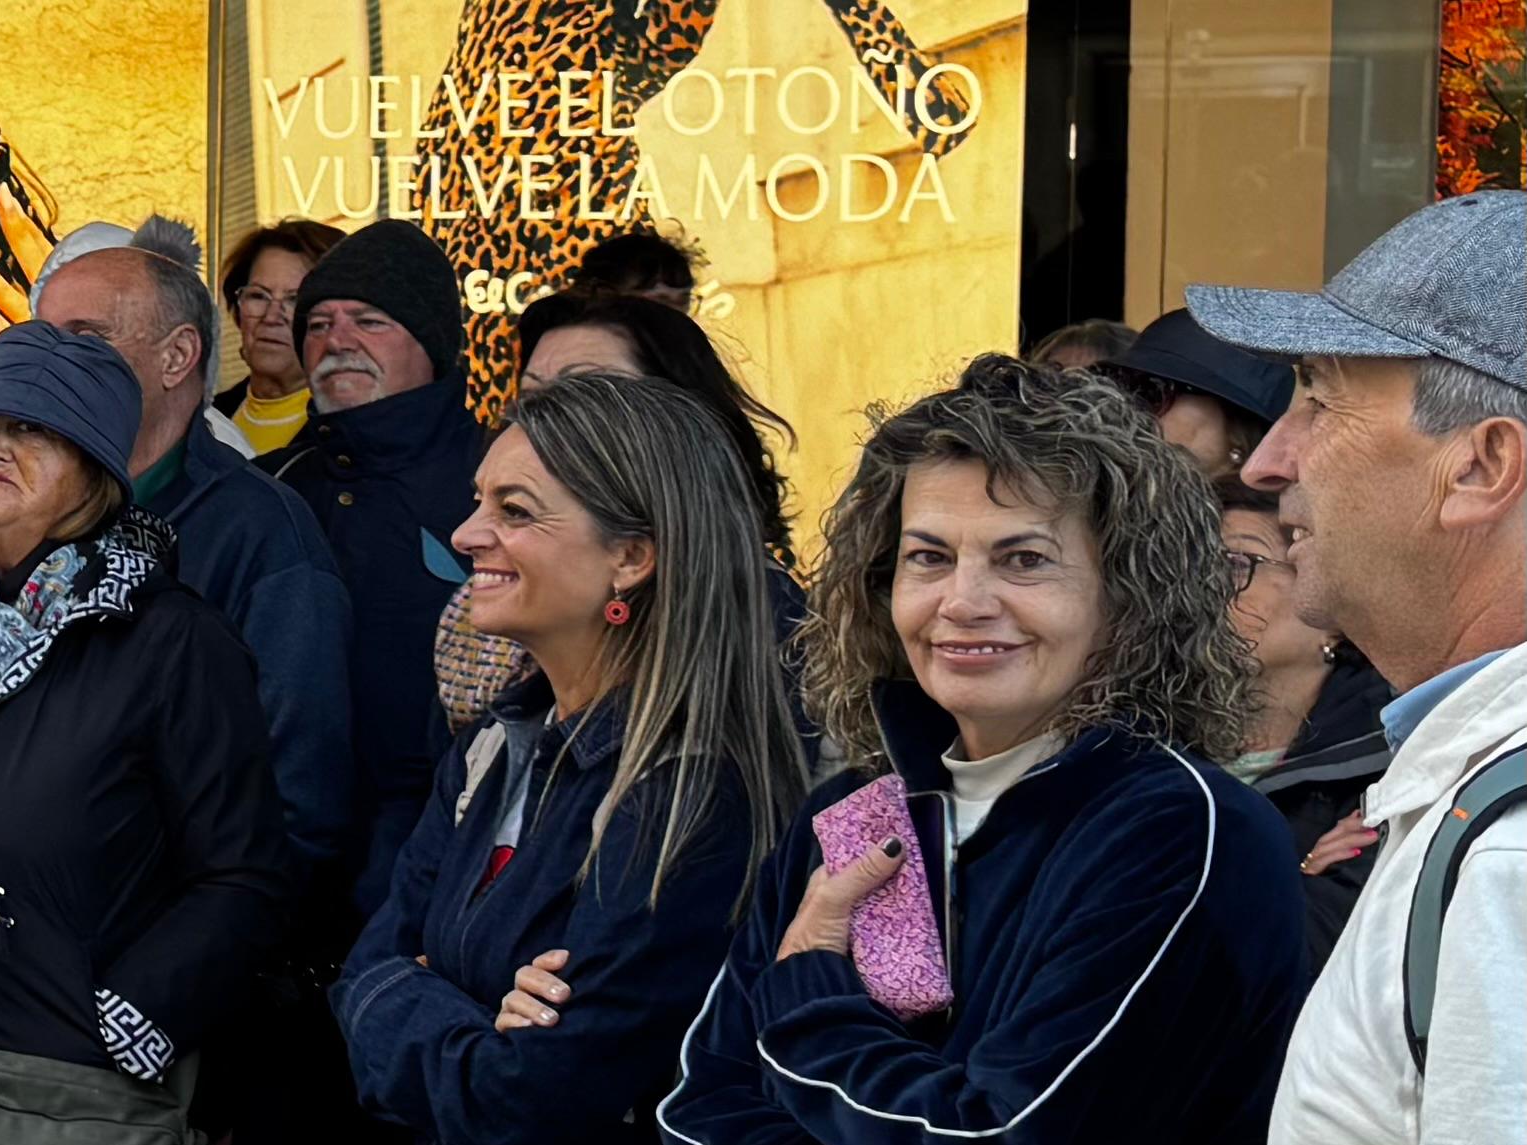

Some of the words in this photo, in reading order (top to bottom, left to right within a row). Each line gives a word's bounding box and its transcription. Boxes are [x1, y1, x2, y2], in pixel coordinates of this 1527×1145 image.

[263, 71, 536, 141] VUELVE
[558, 69, 637, 138] EL
[661, 47, 983, 136] OTOÑO
[282, 153, 556, 221] VUELVE
[577, 152, 672, 221] LA
[693, 153, 957, 223] MODA
